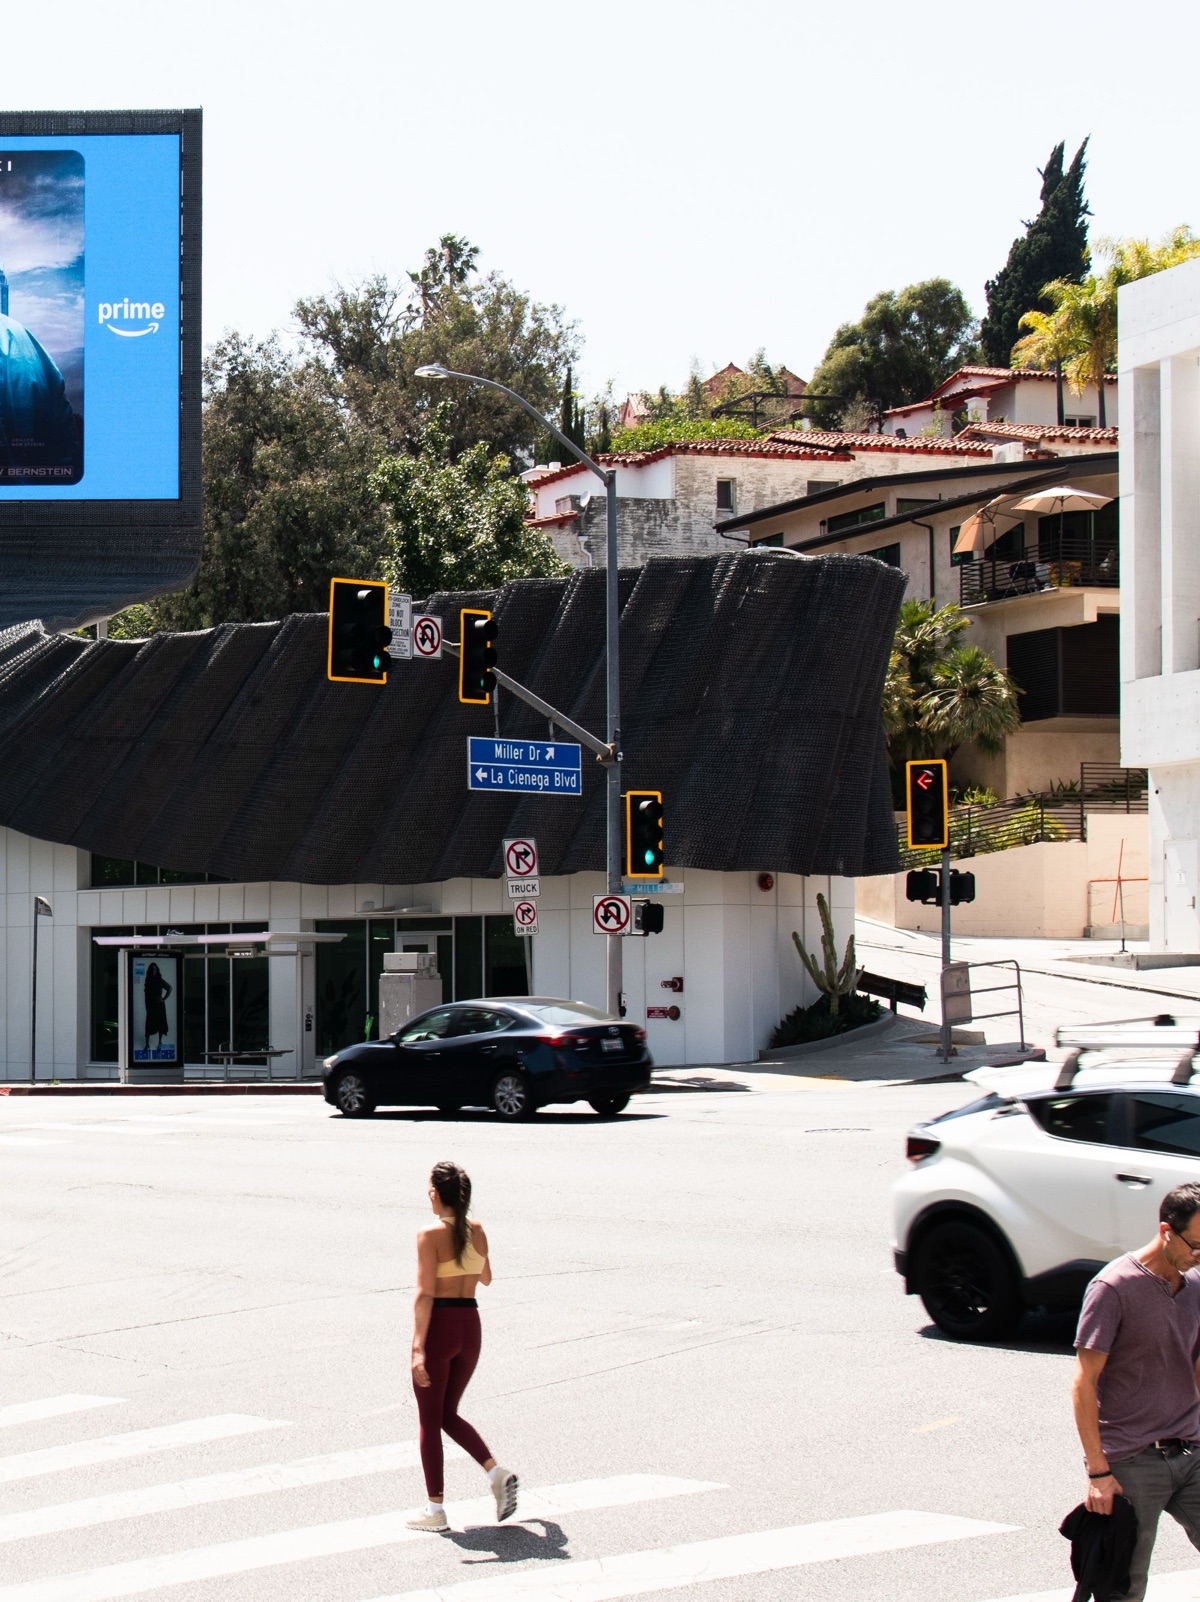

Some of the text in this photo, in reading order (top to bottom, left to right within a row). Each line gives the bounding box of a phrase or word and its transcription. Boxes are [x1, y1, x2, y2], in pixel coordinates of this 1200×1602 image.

[98, 297, 165, 324] prime
[7, 467, 72, 476] BERNSTEIN
[389, 608, 404, 618] DO NOT
[390, 618, 403, 627] BLOCK
[494, 743, 541, 761] Miller Dr
[491, 768, 577, 791] La Cienega Blvd
[510, 884, 537, 893] TRUCK
[516, 925, 538, 934] ON RED
